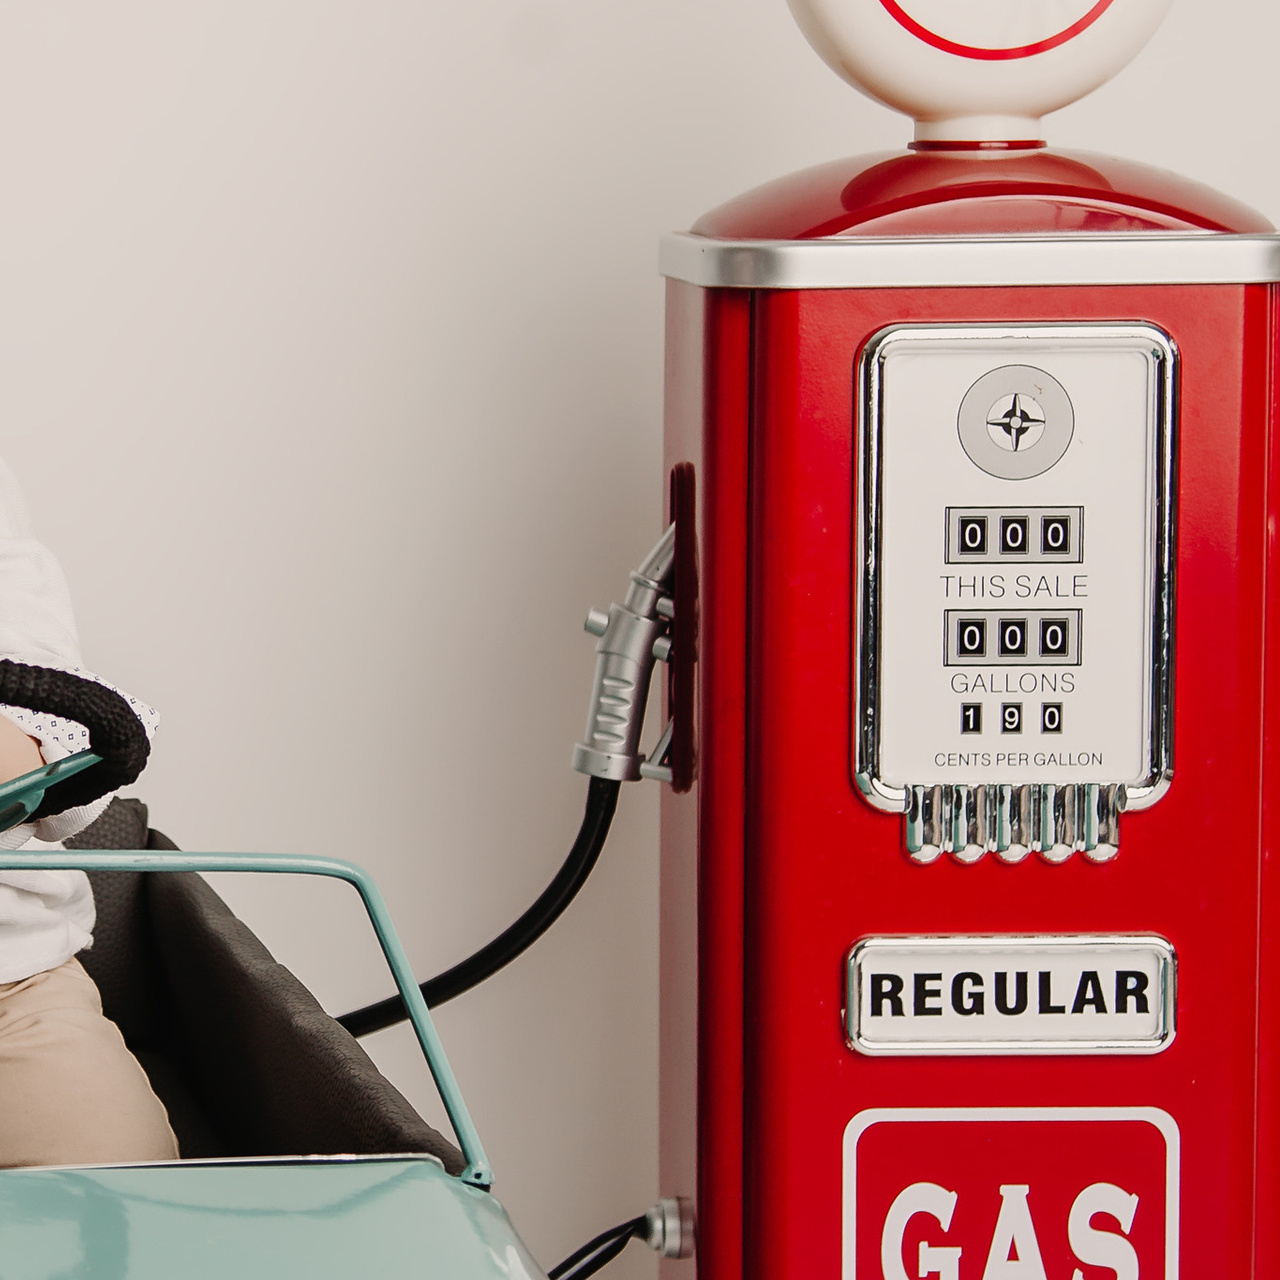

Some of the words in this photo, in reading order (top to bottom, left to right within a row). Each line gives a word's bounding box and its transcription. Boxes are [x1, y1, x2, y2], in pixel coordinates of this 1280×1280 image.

[940, 574, 1006, 598] THIS
[1015, 574, 1088, 598] SALE
[950, 672, 1076, 694] GALLONS
[934, 752, 992, 767] CENTS
[996, 752, 1029, 767] PER
[1033, 752, 1103, 767] GALLON
[870, 970, 1150, 1018] REGULAR
